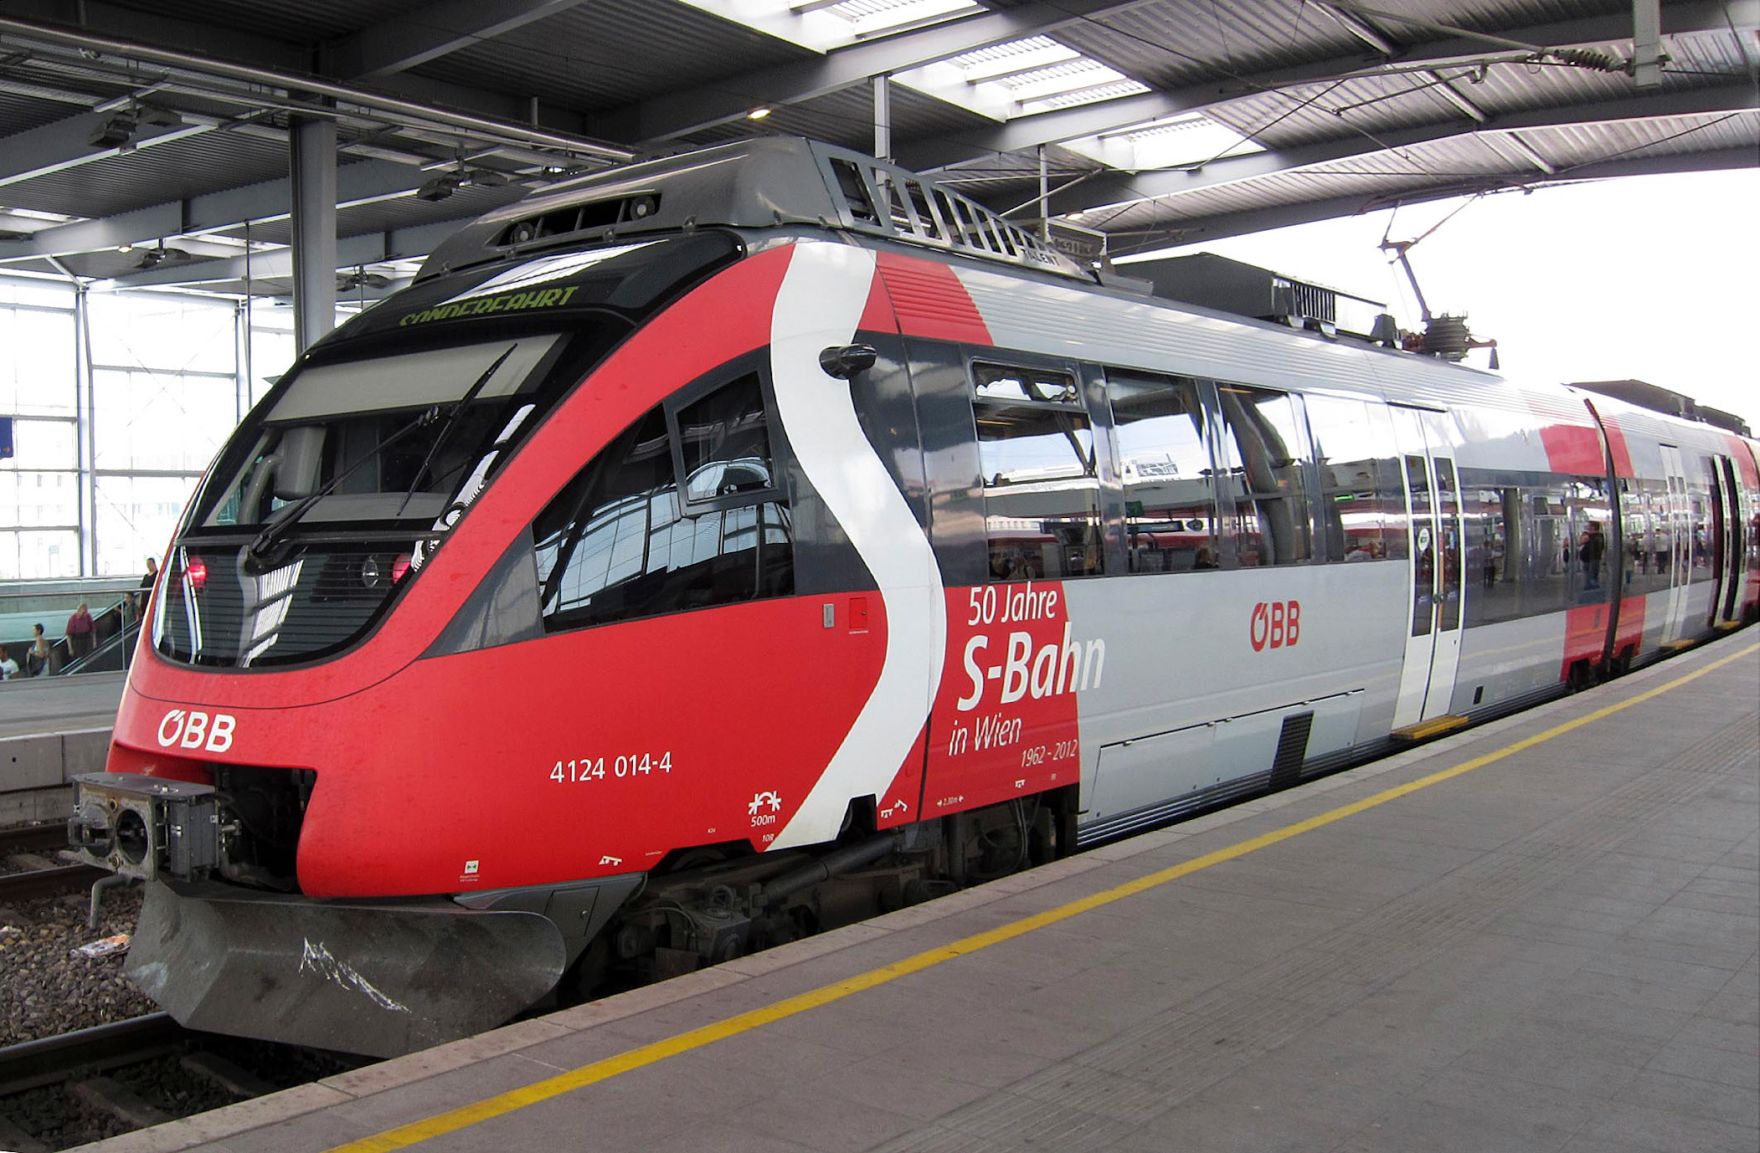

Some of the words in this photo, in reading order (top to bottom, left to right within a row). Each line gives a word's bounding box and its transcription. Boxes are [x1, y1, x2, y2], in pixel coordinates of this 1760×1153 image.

[968, 586, 997, 626] 50
[1001, 581, 1058, 623] Jahre
[1250, 600, 1300, 653] ÖBB
[957, 621, 1106, 712] S-Bahn
[158, 709, 236, 753] ÖBB
[948, 720, 968, 756] in
[974, 712, 1022, 751] Wien
[550, 758, 606, 783] 4124
[614, 751, 673, 778] 014-4
[1021, 746, 1046, 768] 1962
[1052, 740, 1078, 761] 2012
[751, 815, 776, 828] 500m
